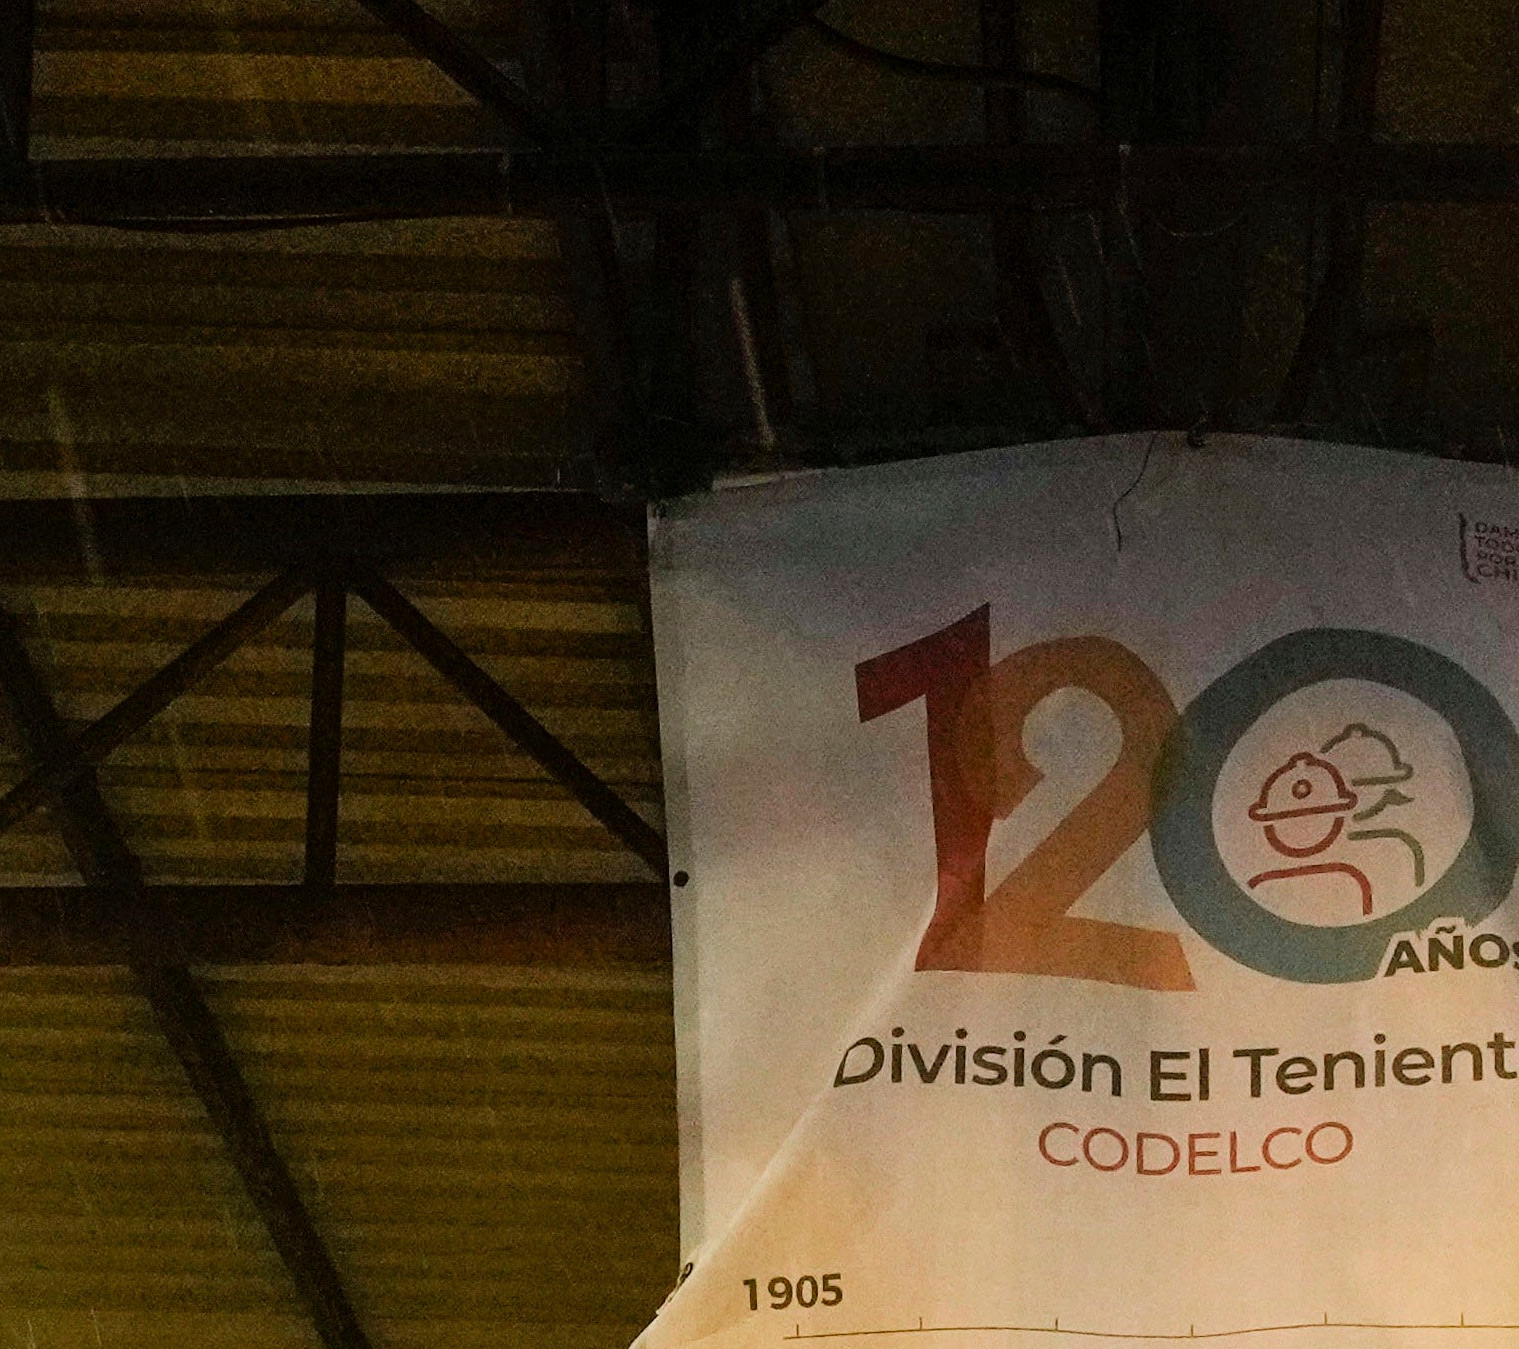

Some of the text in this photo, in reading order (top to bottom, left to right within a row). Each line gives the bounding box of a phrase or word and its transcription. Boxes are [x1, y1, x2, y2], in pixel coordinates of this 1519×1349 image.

[833, 1027, 1122, 1096] División
[1150, 1048, 1211, 1101] El
[1037, 1121, 1355, 1177] CODELCO
[742, 1273, 844, 1311] 1905
